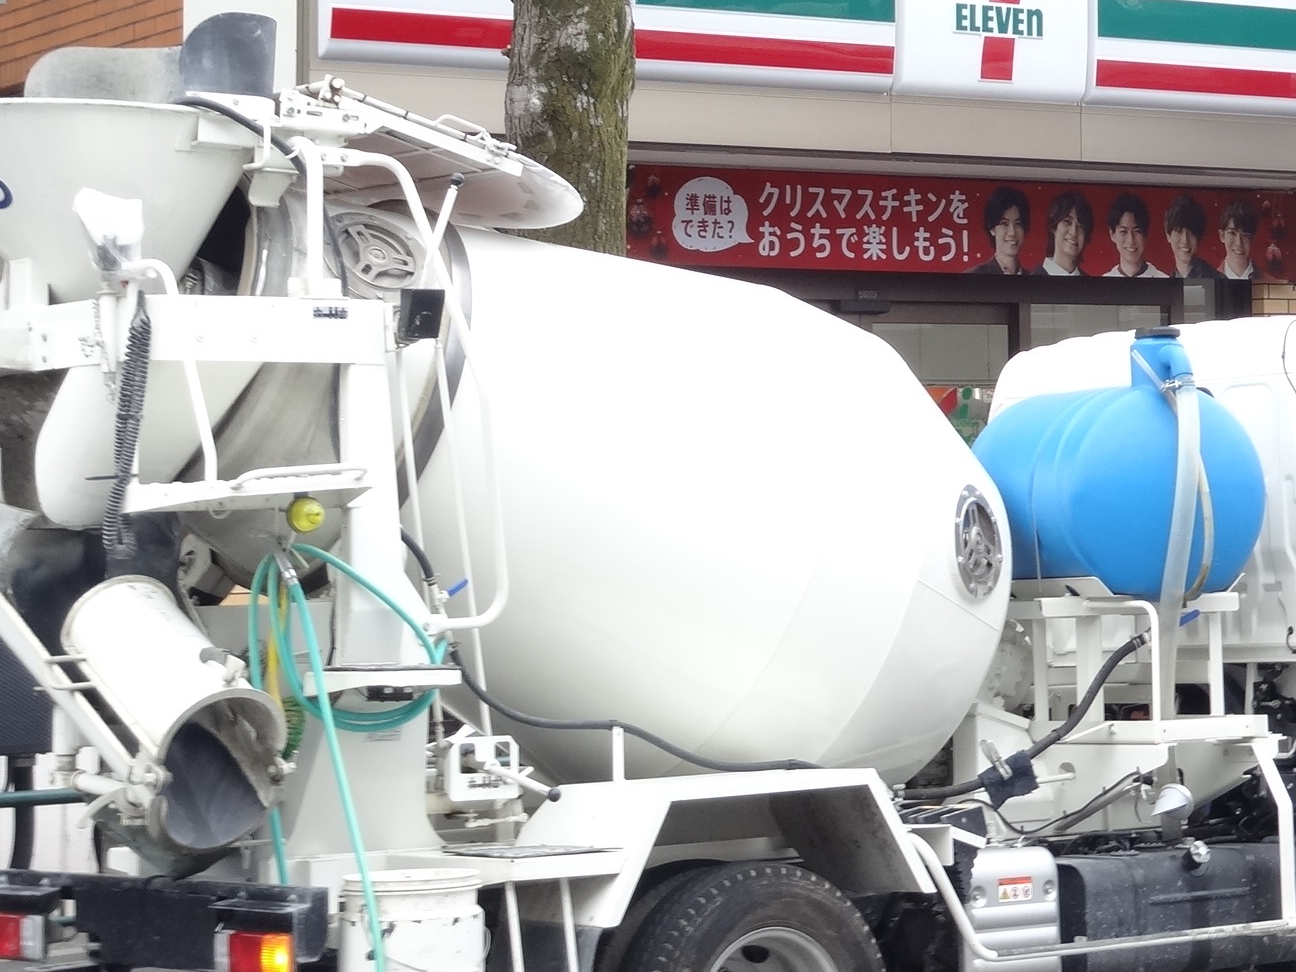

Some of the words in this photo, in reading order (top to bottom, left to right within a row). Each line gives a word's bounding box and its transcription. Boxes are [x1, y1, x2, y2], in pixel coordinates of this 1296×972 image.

[685, 192, 732, 216] 準備は
[758, 181, 969, 224] クリスマスチキンを
[680, 219, 736, 240] できた?
[758, 221, 970, 262] おうちで楽しもう!
